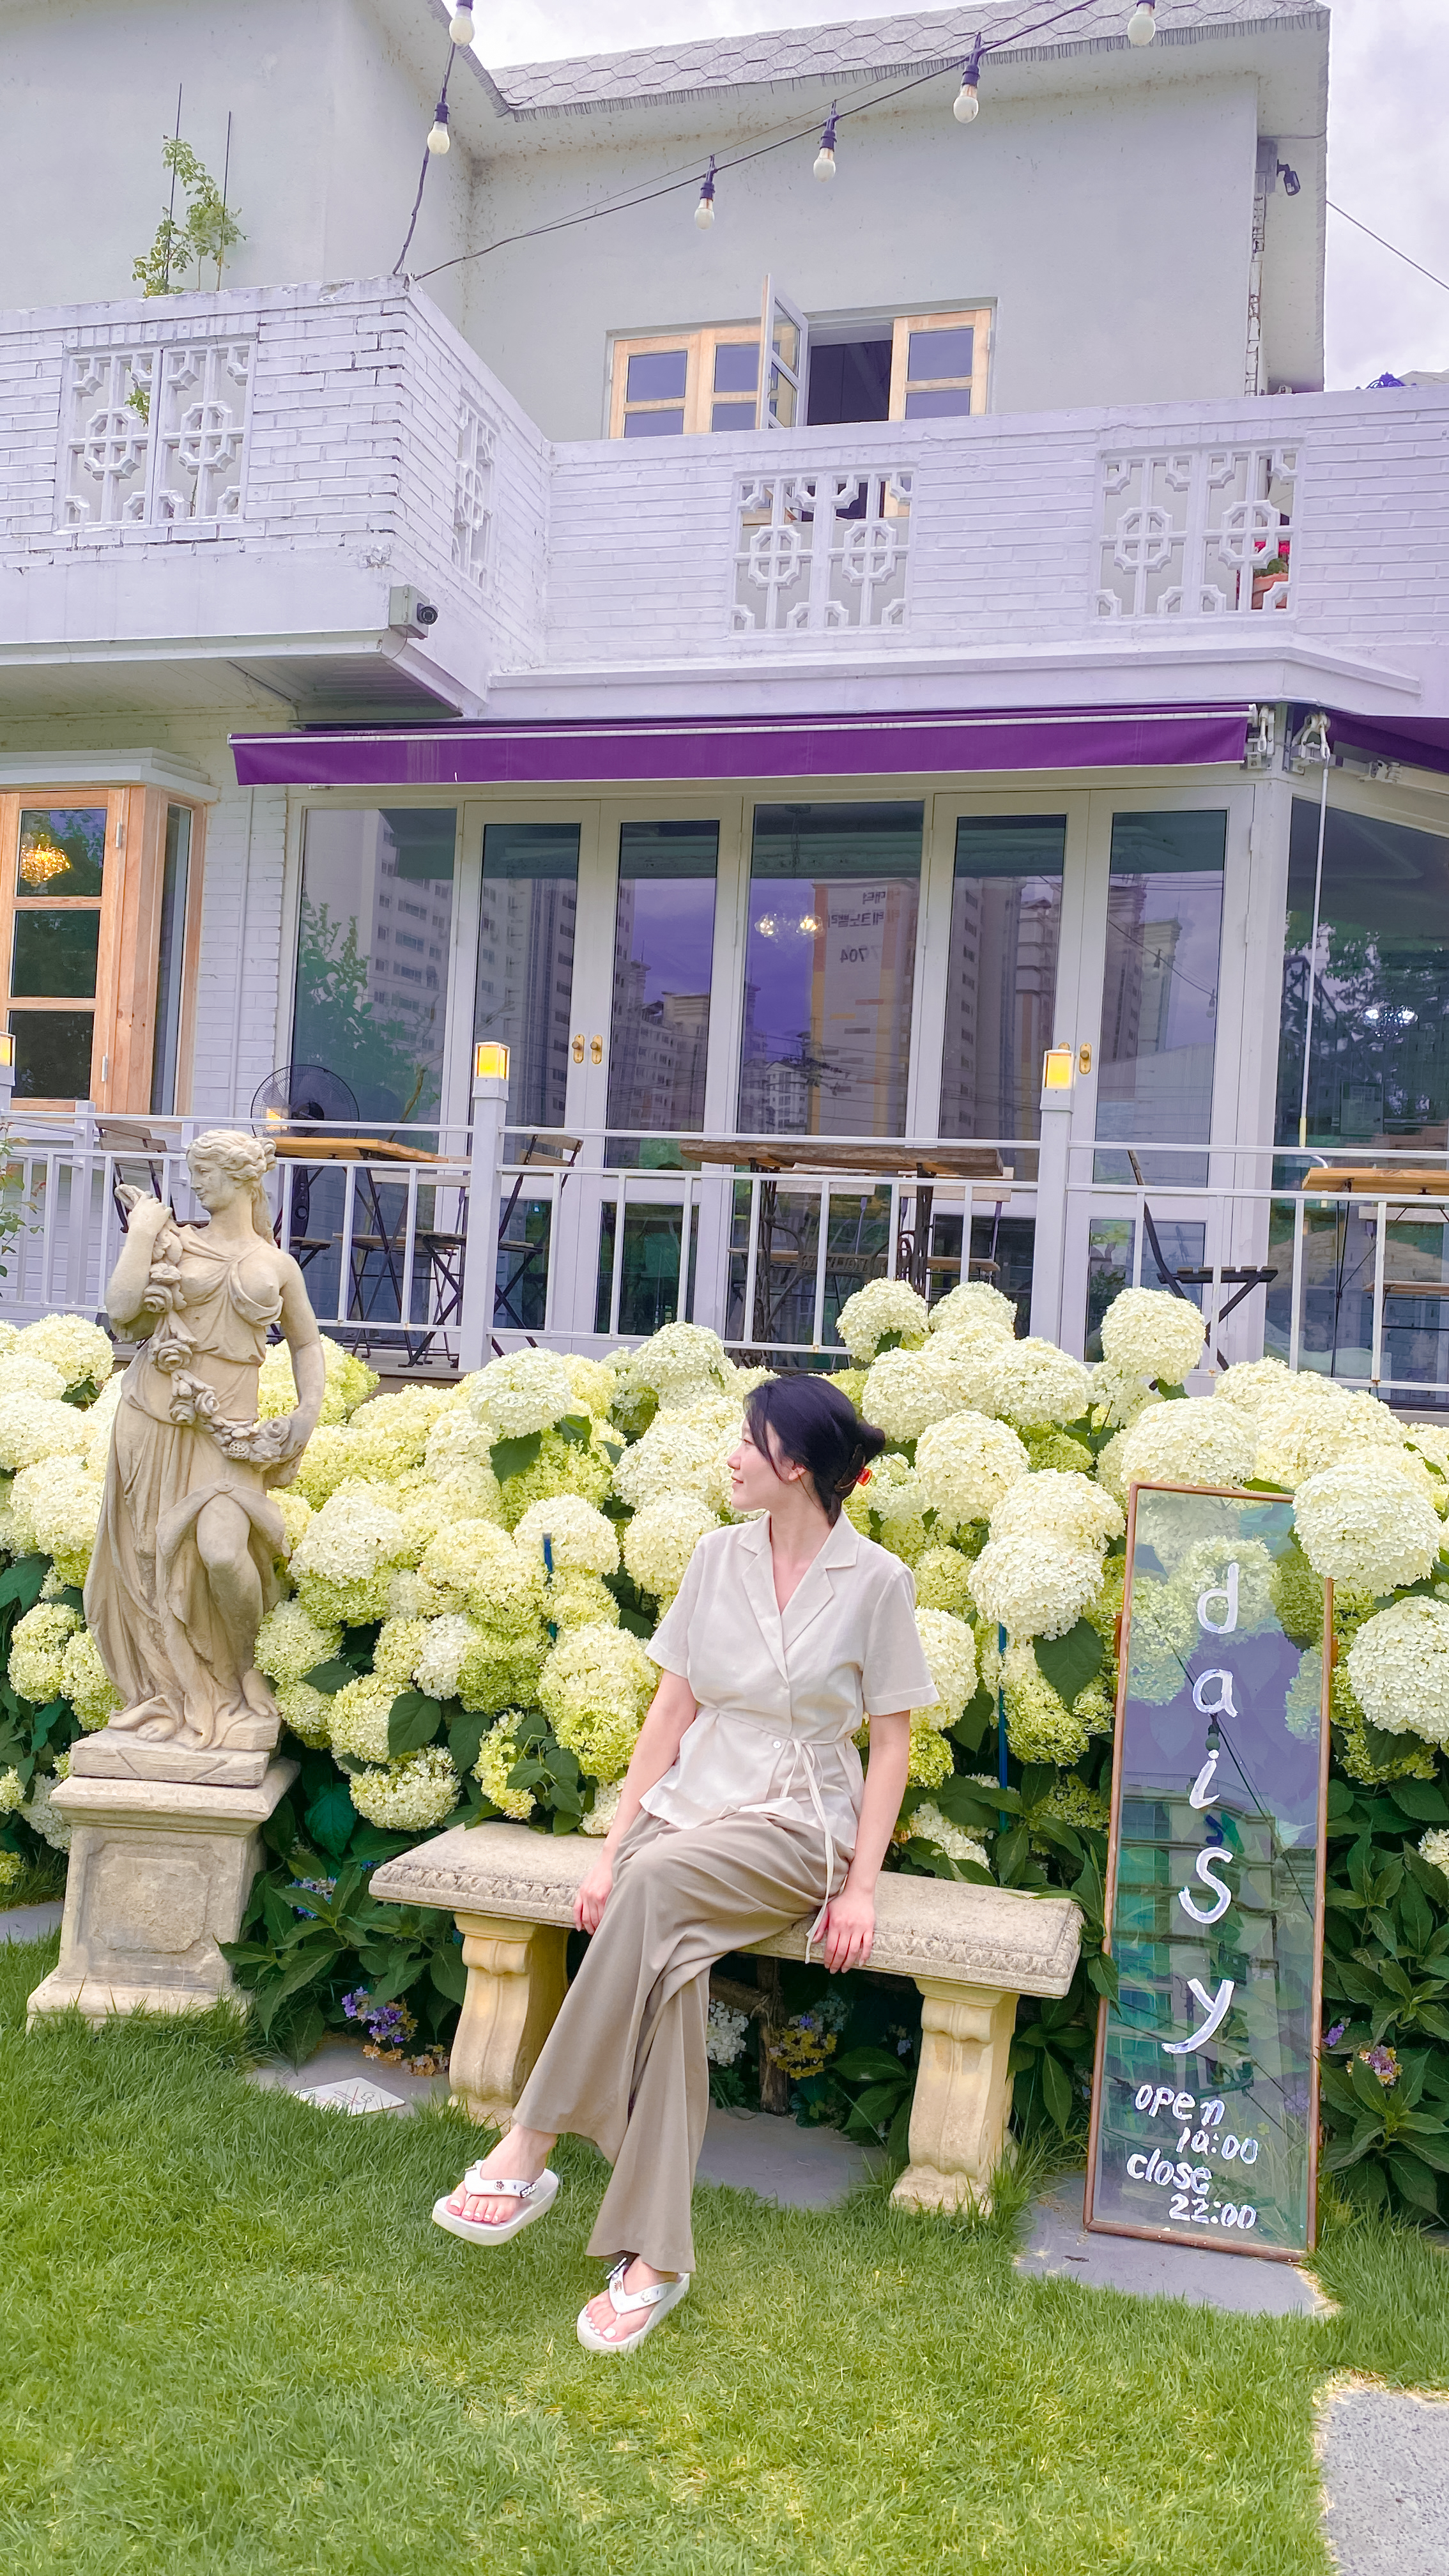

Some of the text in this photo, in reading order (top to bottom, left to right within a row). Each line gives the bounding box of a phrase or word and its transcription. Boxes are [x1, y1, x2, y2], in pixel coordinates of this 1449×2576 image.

[1135, 2084, 1225, 2127] open
[1176, 2126, 1259, 2165] 10:00
[1126, 2148, 1212, 2195] close
[1169, 2193, 1257, 2230] 22:00
